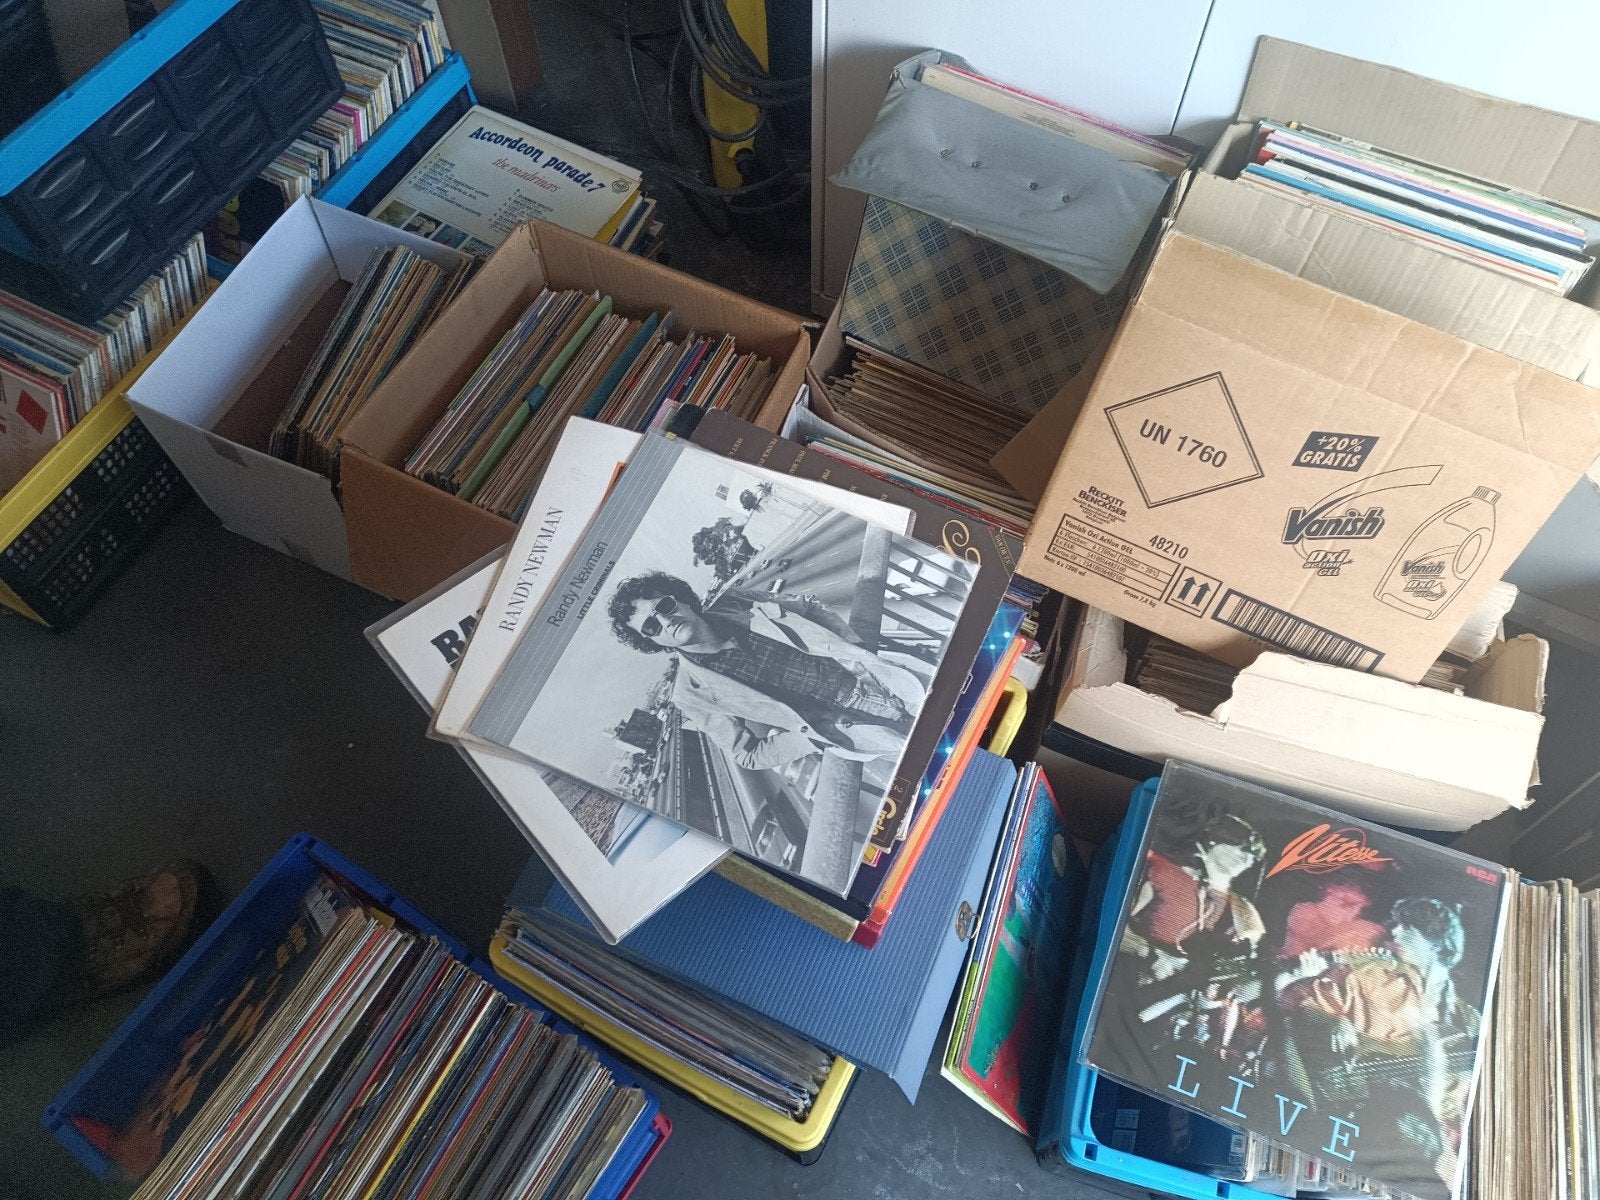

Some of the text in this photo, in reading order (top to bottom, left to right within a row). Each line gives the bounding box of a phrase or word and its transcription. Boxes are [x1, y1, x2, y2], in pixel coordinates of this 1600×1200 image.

[468, 126, 541, 164] Accordeon
[543, 154, 592, 191] parade
[492, 156, 509, 174] the
[1139, 418, 1228, 469] UN 1760
[1317, 435, 1366, 453] +20%
[1299, 451, 1363, 468] GRATIS
[1078, 490, 1127, 517] BENCKISER
[1087, 485, 1124, 508] RECKITT
[1064, 519, 1086, 533] Vanish
[1086, 529, 1098, 539] Oxi
[1099, 535, 1120, 548] Action
[1281, 503, 1386, 545] Vanish
[1148, 533, 1189, 560] 48210
[1306, 550, 1350, 566] Oxi
[498, 506, 564, 633] RANDY NEWMAN
[1400, 559, 1446, 577] Vanish
[547, 541, 609, 628] Randy Newman
[576, 595, 594, 620] LITTLE
[430, 607, 484, 665] RA
[1466, 866, 1497, 884] RCA
[1168, 1055, 1360, 1162] LIVE
